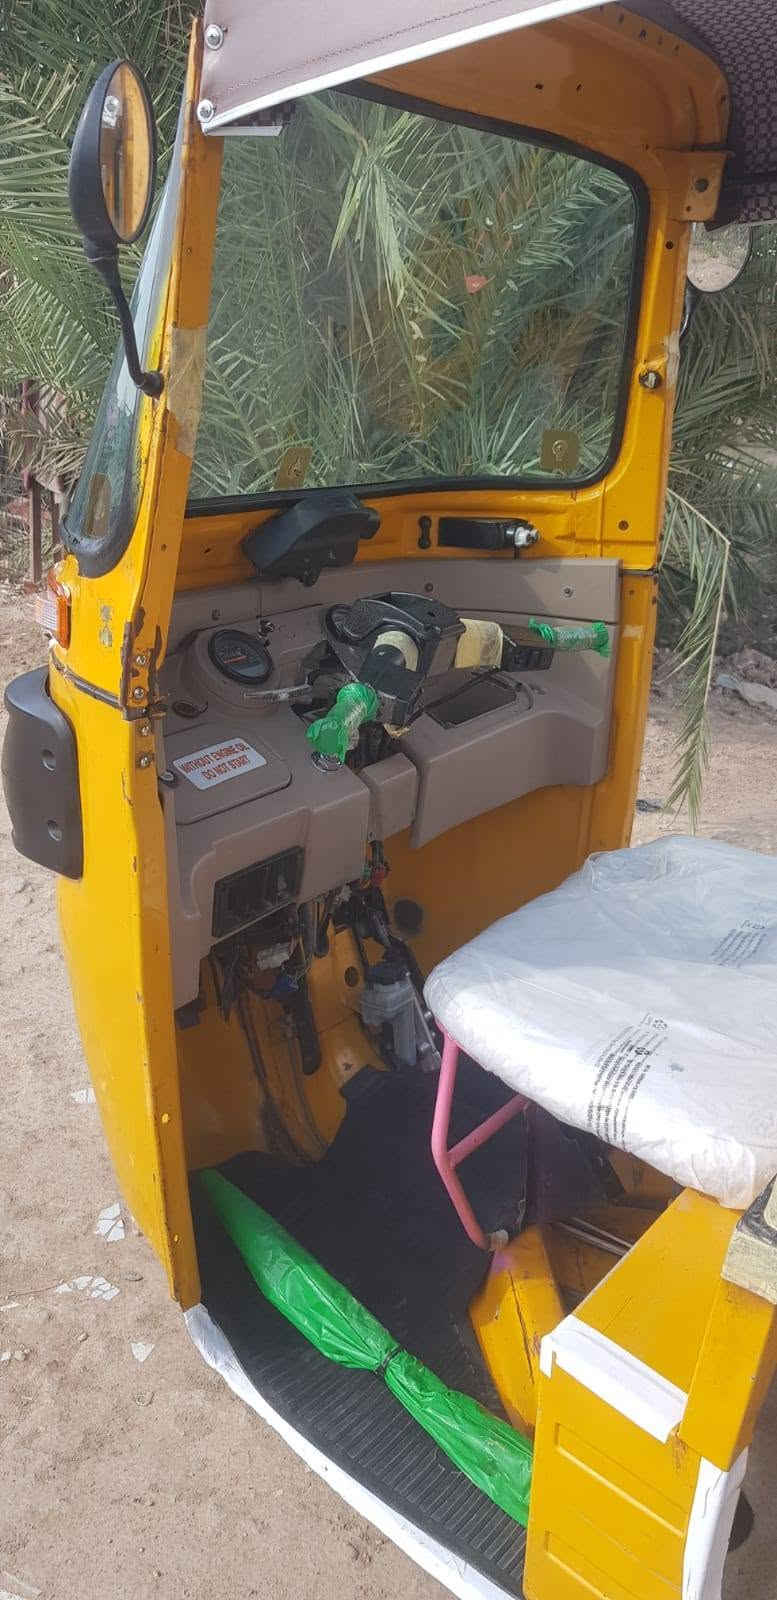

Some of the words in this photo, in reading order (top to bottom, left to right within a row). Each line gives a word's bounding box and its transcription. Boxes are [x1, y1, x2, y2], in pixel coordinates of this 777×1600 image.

[179, 754, 213, 774] WITHOUT
[211, 744, 238, 761] ENGINE
[236, 742, 250, 753] OIL
[201, 768, 216, 780] DO
[213, 762, 232, 777] NOT
[228, 755, 250, 769] START
